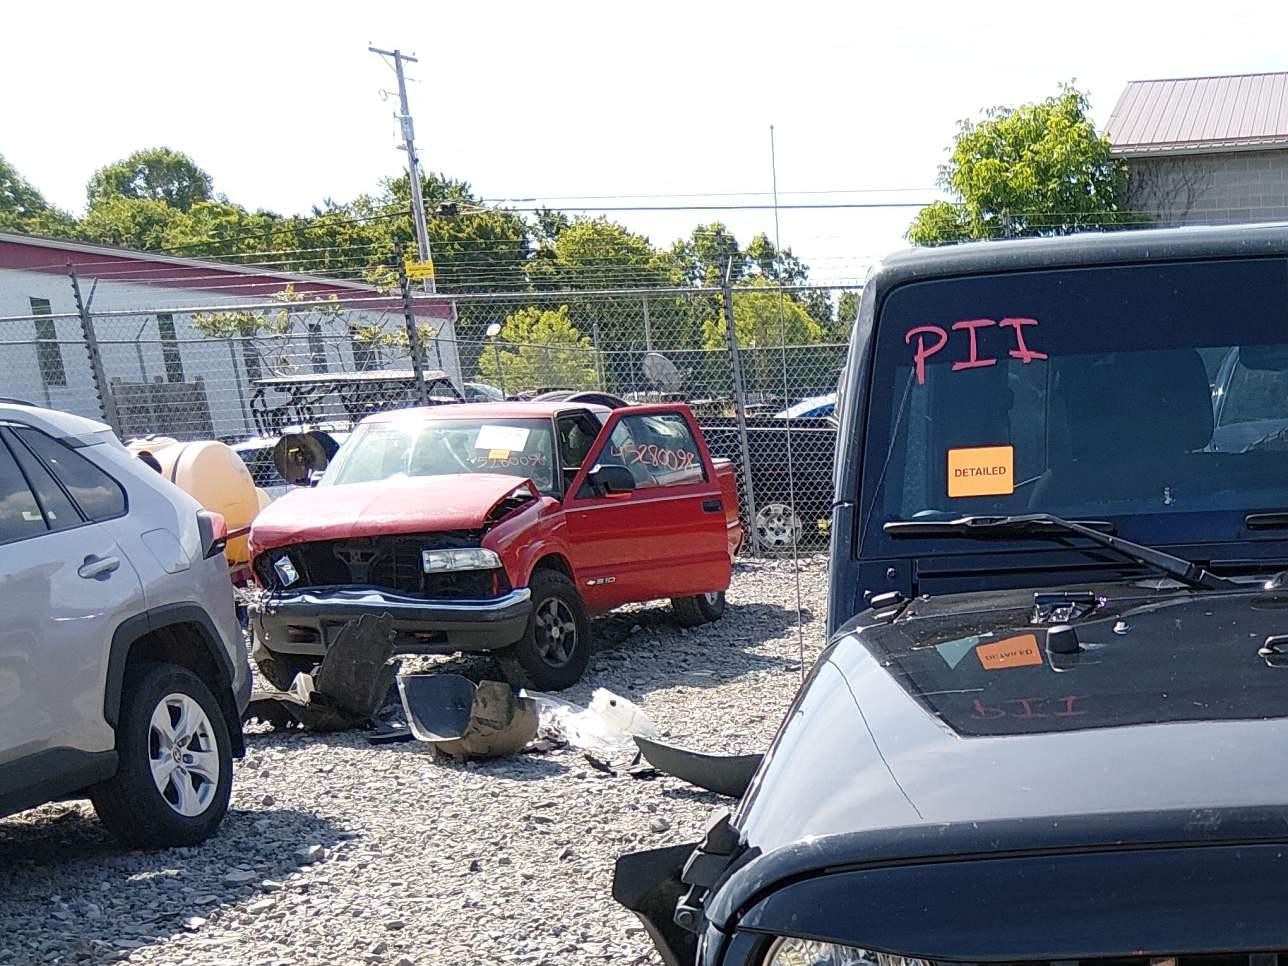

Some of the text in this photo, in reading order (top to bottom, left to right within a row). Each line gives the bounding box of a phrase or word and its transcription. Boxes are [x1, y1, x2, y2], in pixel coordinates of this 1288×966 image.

[905, 317, 1048, 384] PII
[610, 441, 695, 472] 45280098
[954, 466, 1007, 478] DETAILED
